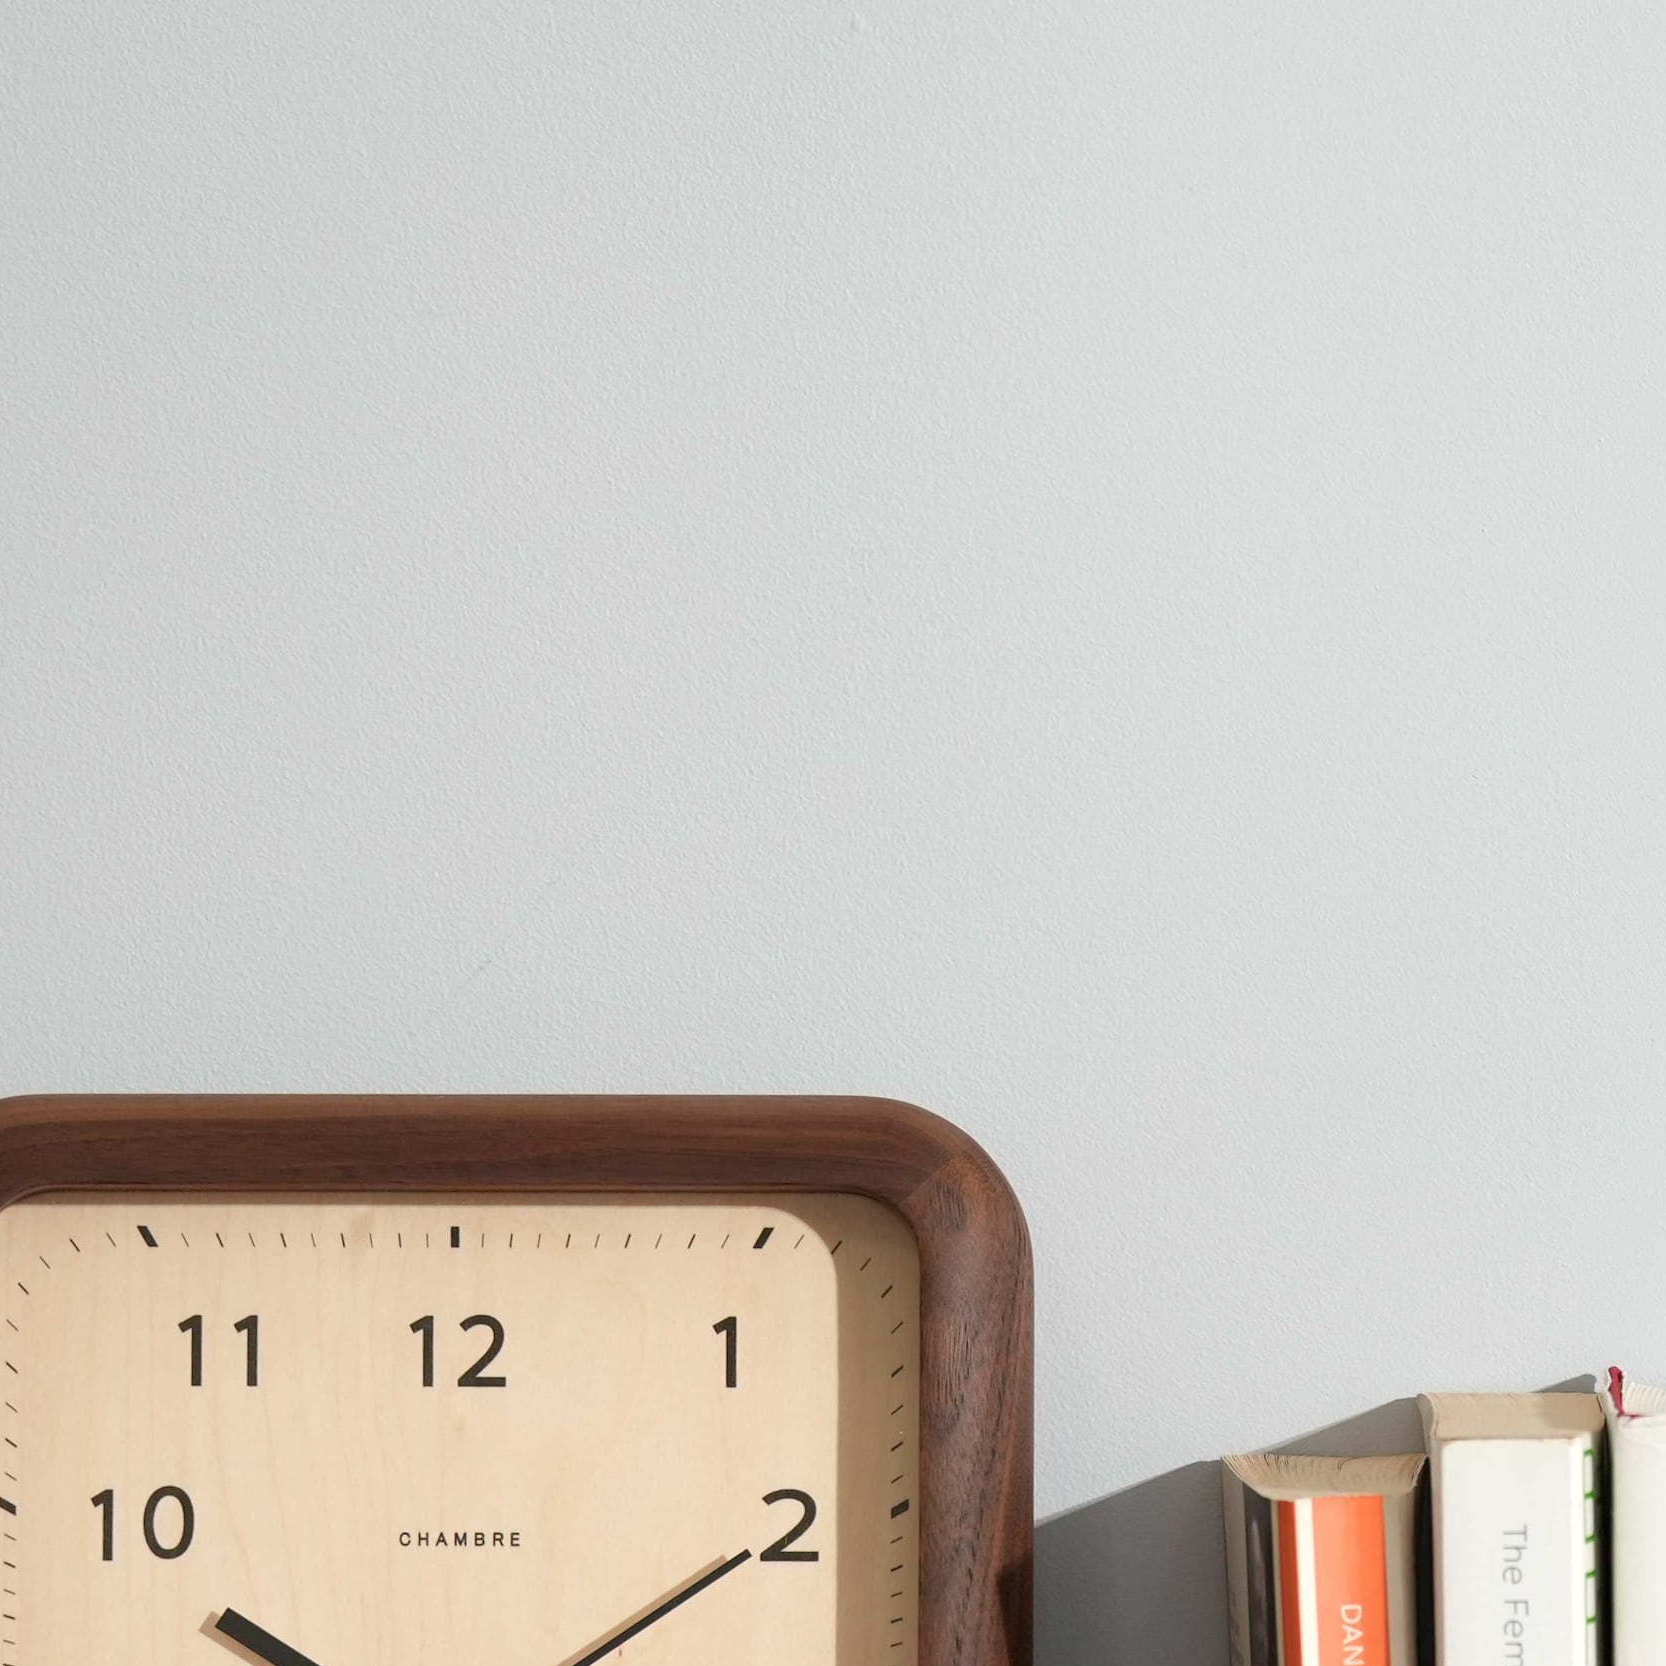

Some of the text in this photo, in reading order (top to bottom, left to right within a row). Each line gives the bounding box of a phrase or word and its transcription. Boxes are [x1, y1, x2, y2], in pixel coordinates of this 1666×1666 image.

[177, 1314, 259, 1388] 11
[409, 1314, 507, 1388] 12
[712, 1315, 738, 1389] 1
[90, 1485, 195, 1562] 10
[398, 1530, 522, 1548] CHAMBRE
[760, 1488, 820, 1563] 2
[1502, 1524, 1528, 1585] The
